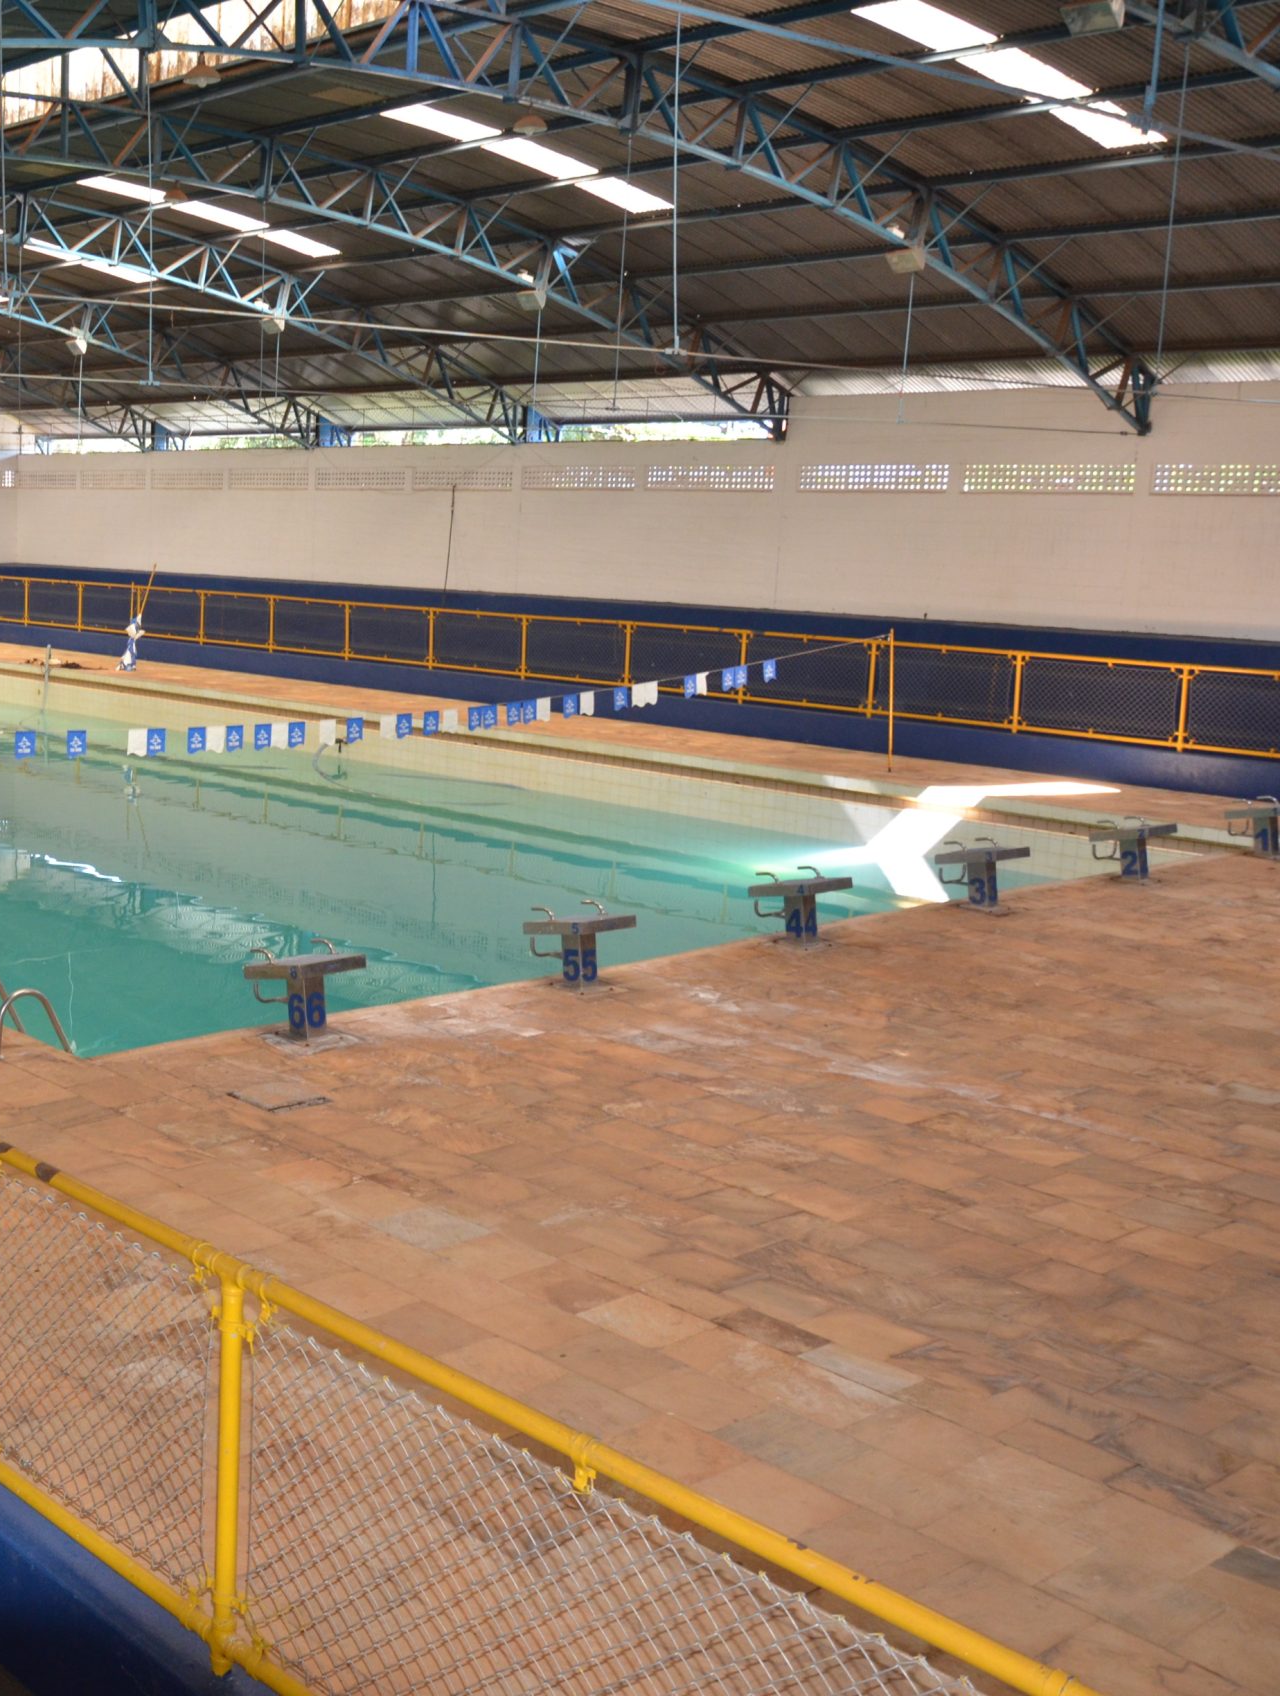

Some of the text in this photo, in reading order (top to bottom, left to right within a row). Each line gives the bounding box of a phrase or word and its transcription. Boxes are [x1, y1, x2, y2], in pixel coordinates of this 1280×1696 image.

[1255, 828, 1269, 851] 1
[1121, 851, 1138, 876] 2
[969, 878, 986, 904] 3
[571, 922, 579, 934] 5
[786, 908, 803, 937] 4
[804, 907, 817, 937] 4
[563, 949, 580, 981] 5
[581, 949, 597, 982] 5
[288, 993, 305, 1028] 6
[307, 992, 326, 1028] 6
